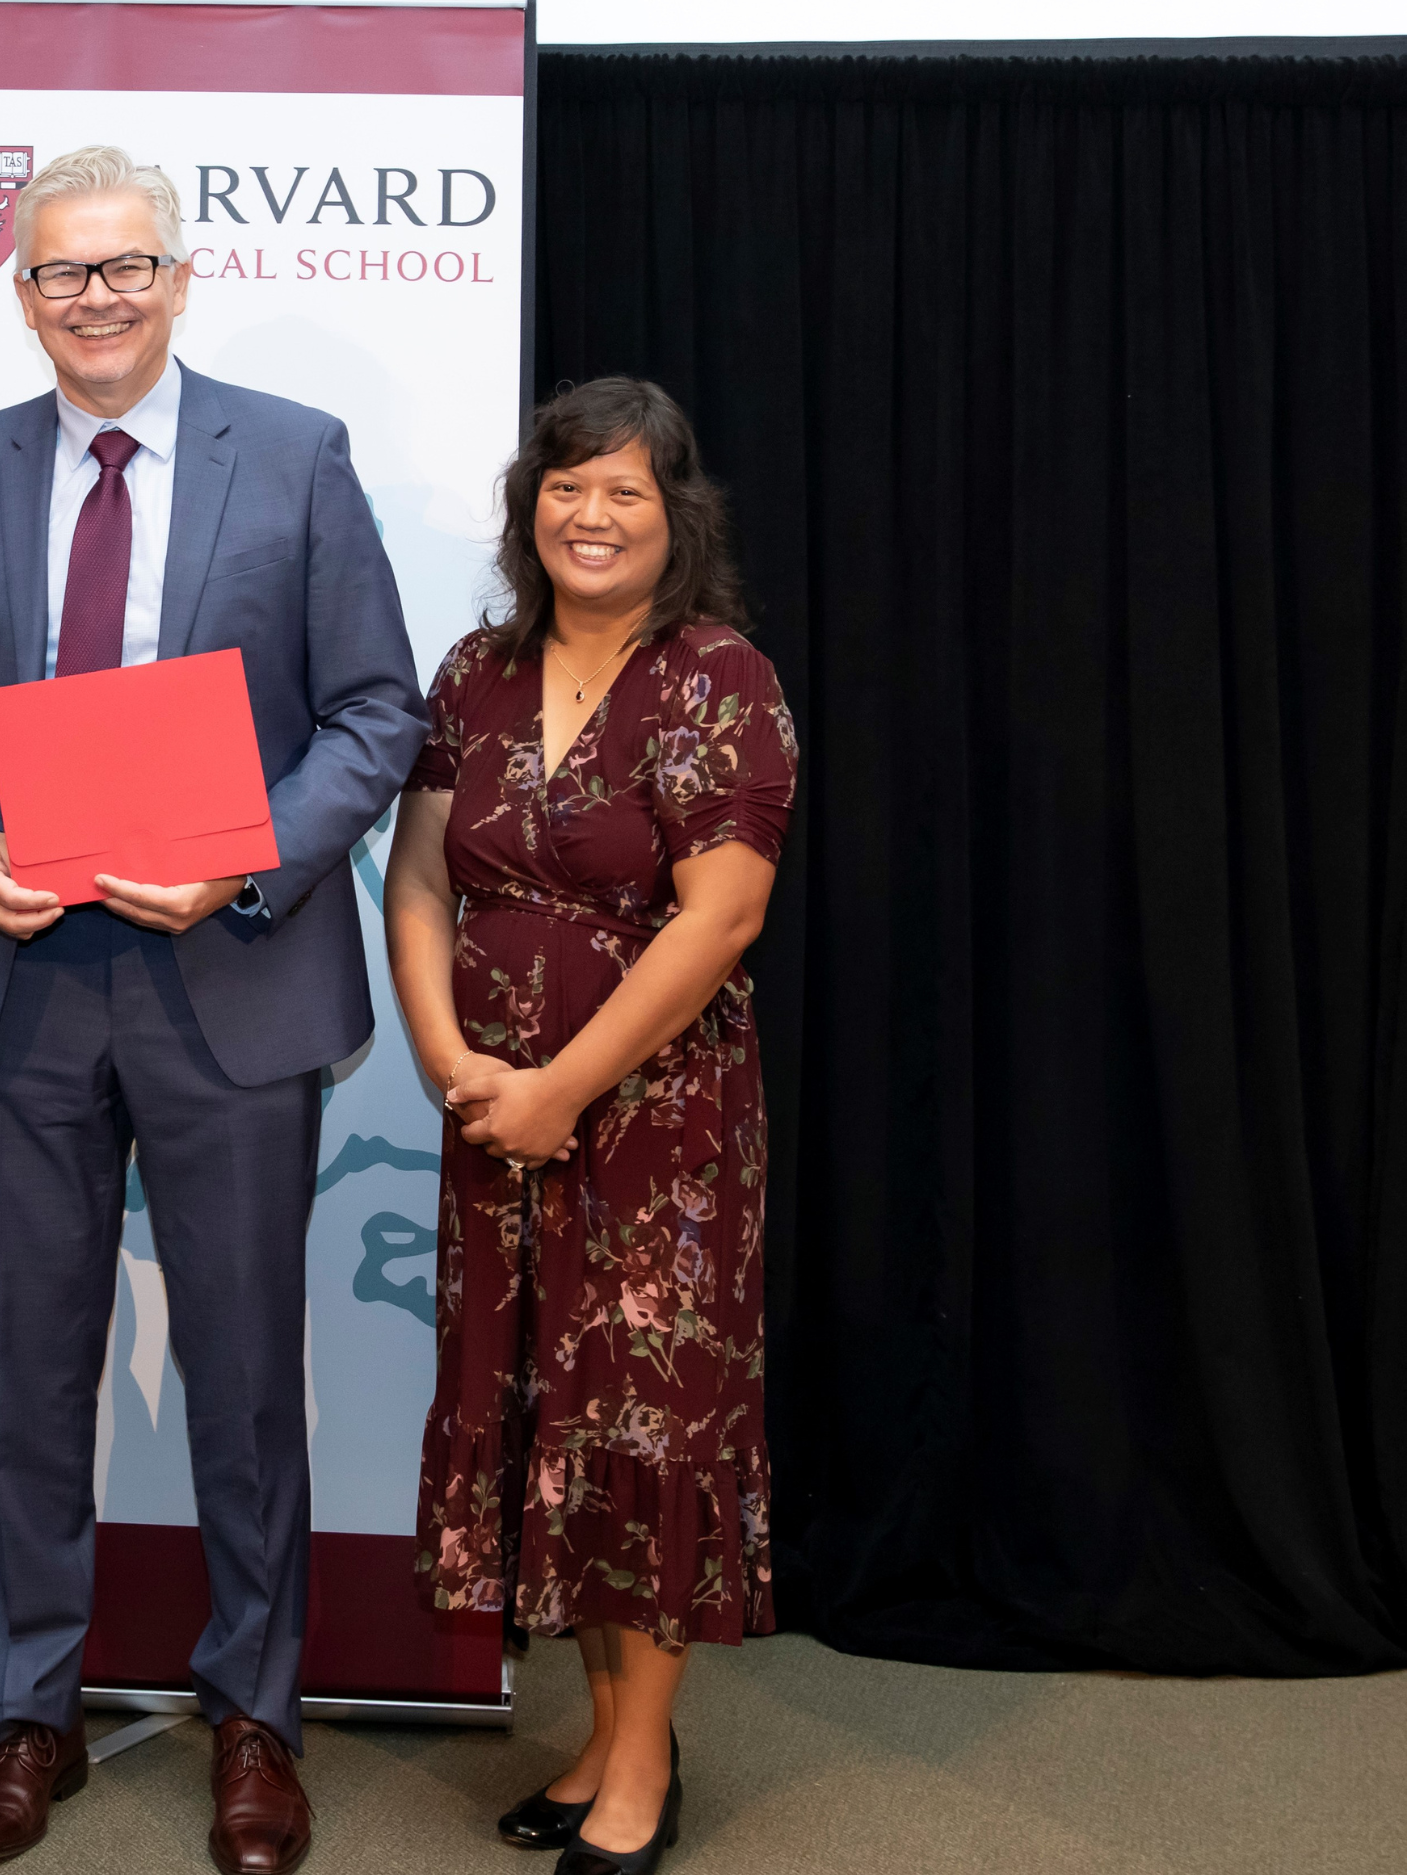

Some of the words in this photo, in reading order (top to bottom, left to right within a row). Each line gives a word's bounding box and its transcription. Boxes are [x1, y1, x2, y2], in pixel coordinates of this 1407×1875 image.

[3, 156, 23, 168] TAS
[155, 165, 496, 226] RVARD
[296, 248, 494, 283] SCHOOL
